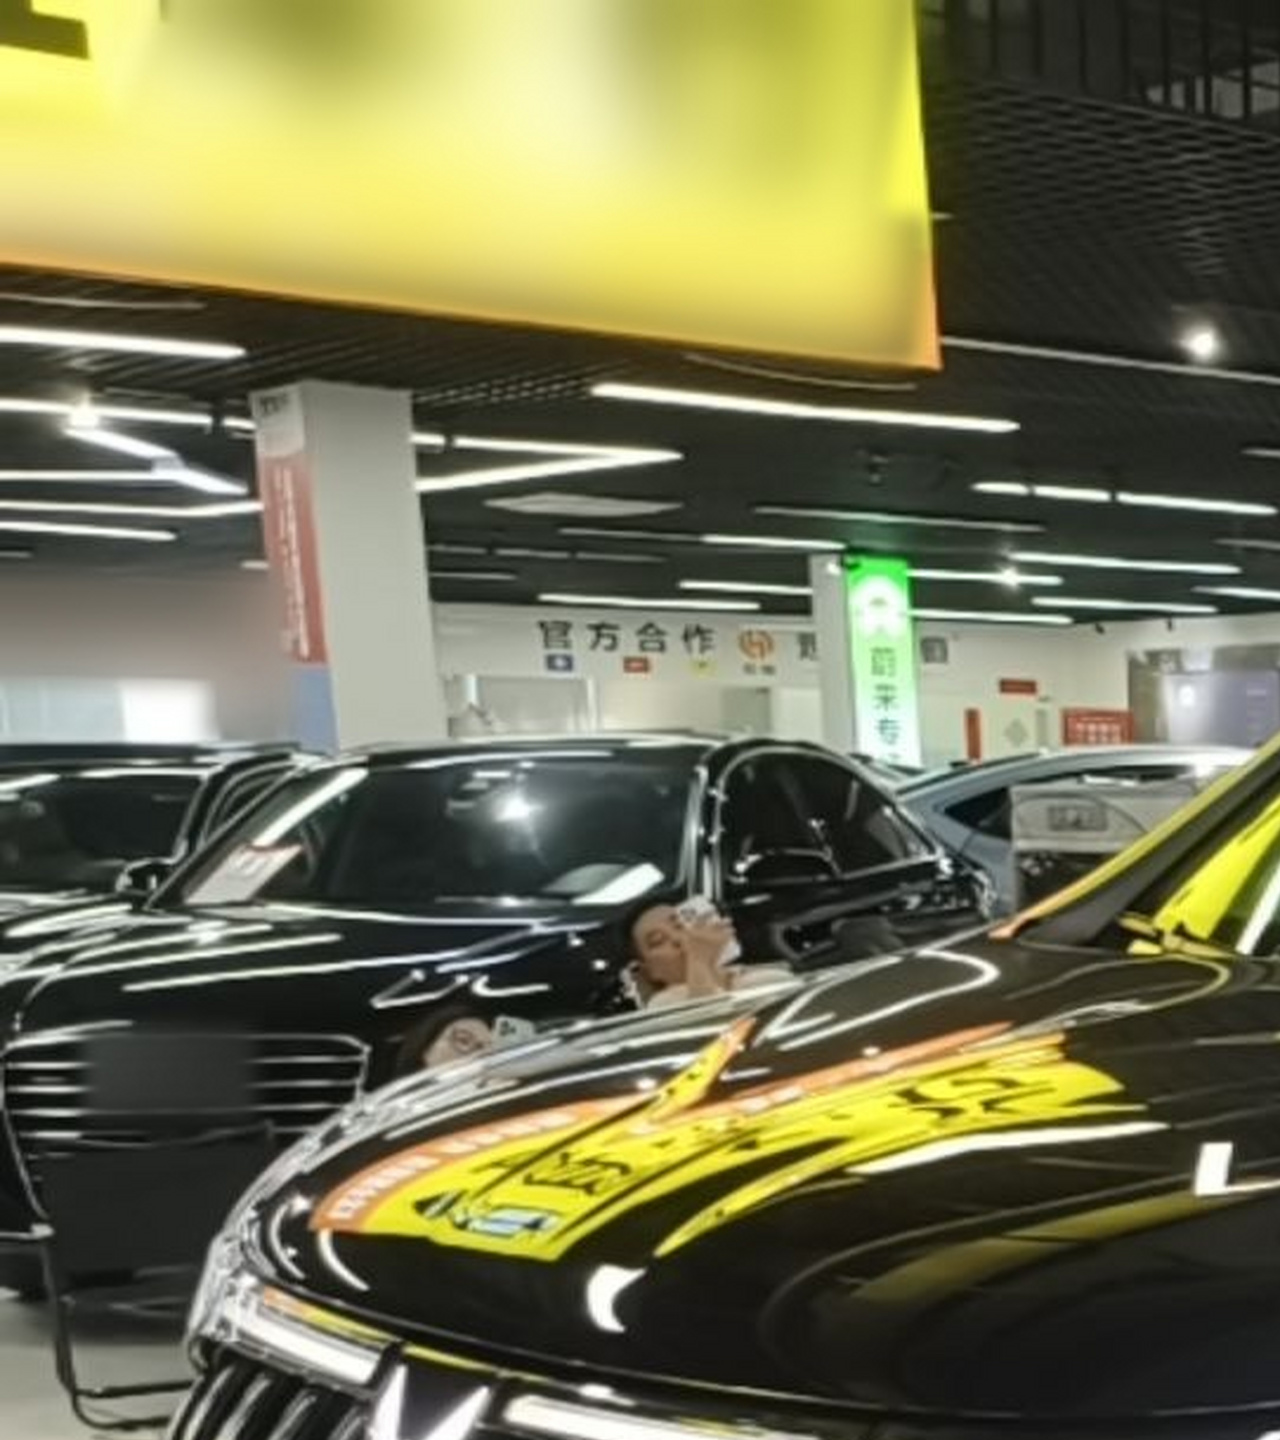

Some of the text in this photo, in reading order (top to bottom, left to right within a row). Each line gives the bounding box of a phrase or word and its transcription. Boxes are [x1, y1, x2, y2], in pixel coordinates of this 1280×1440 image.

[538, 620, 716, 654] 官方合作
[869, 646, 902, 764] 蔚来专
